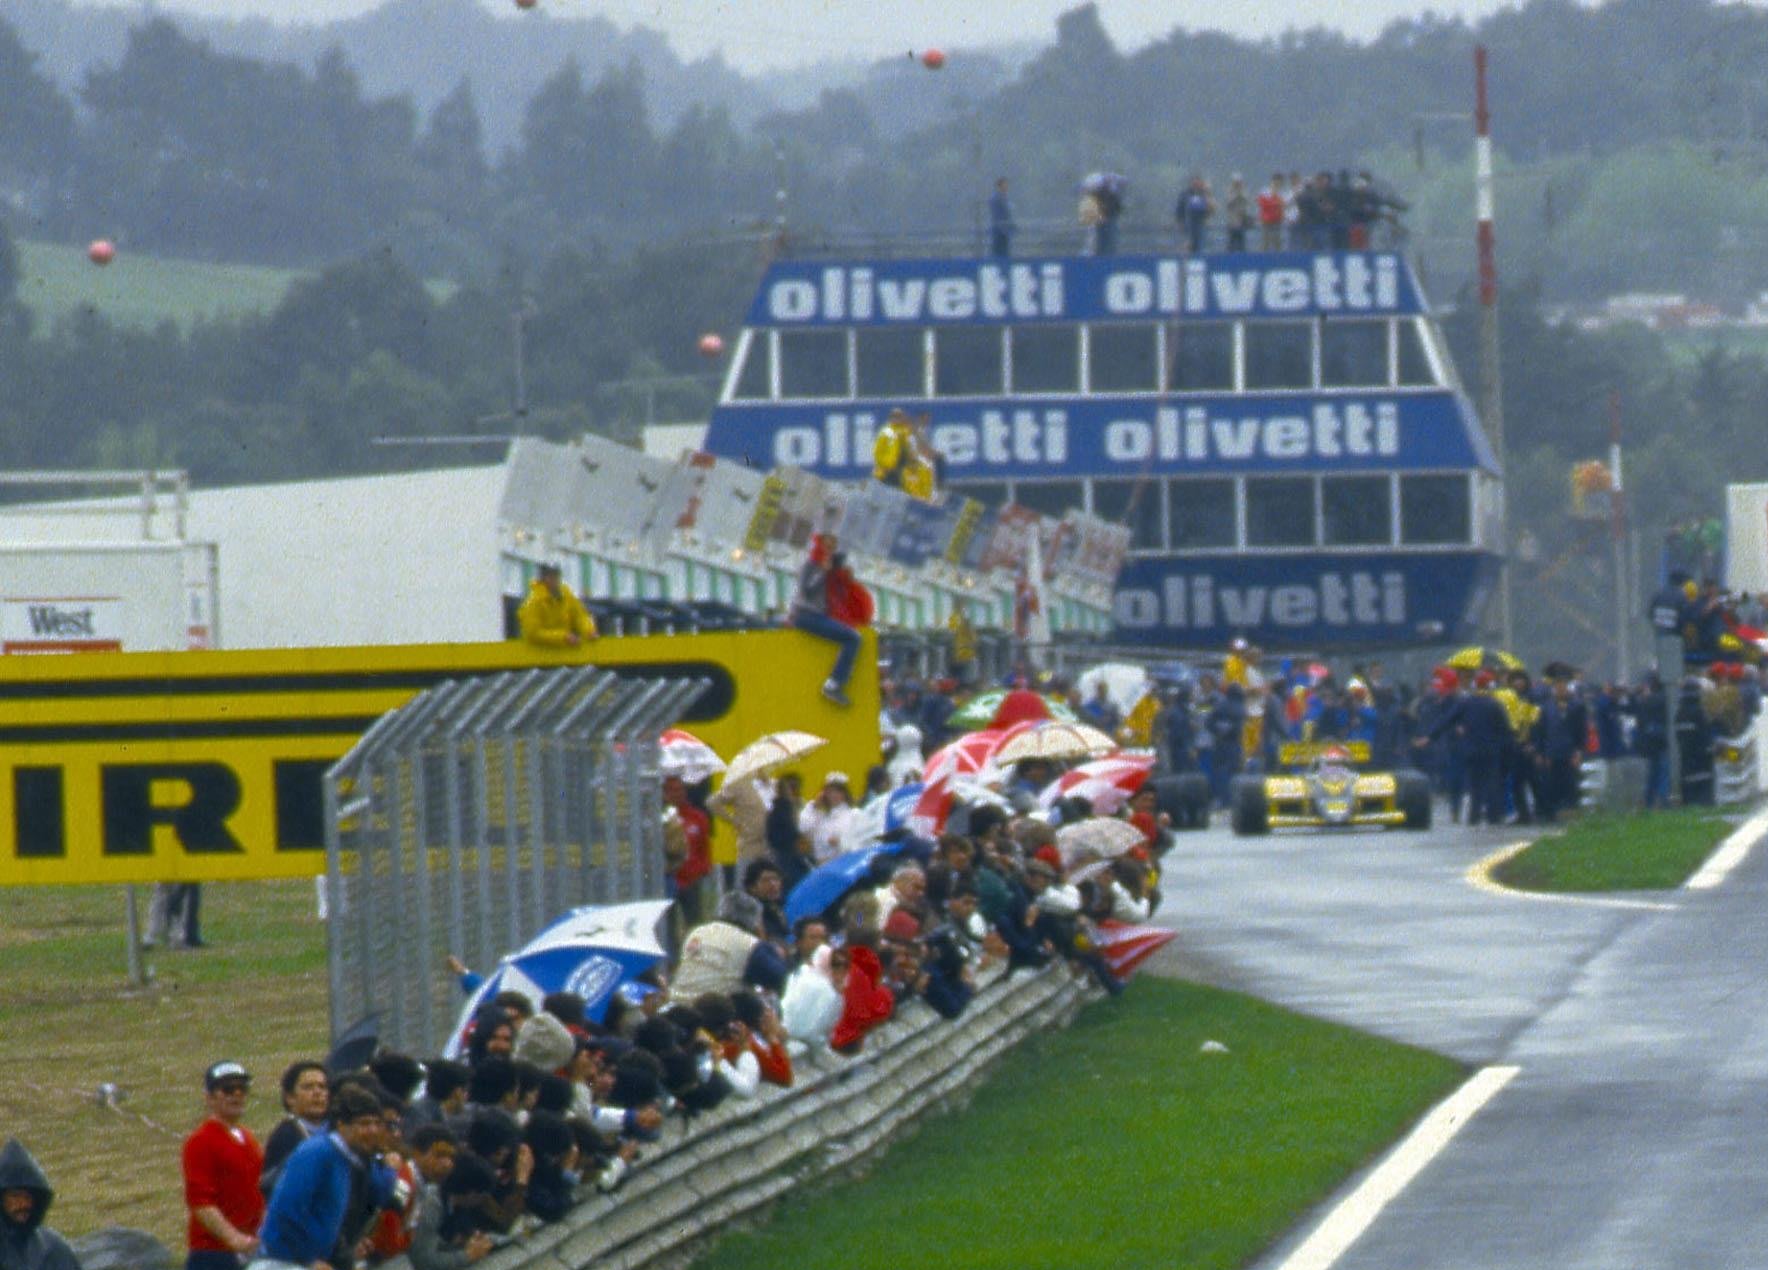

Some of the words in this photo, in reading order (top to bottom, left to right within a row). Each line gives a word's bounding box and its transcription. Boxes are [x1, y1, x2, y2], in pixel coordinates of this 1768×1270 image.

[770, 264, 1064, 321] olivetti
[1105, 254, 1397, 315] olivetti
[774, 408, 1067, 467] olietti
[1105, 402, 1398, 461] olivetti
[29, 605, 93, 635] West
[1114, 573, 1406, 628] olivetti
